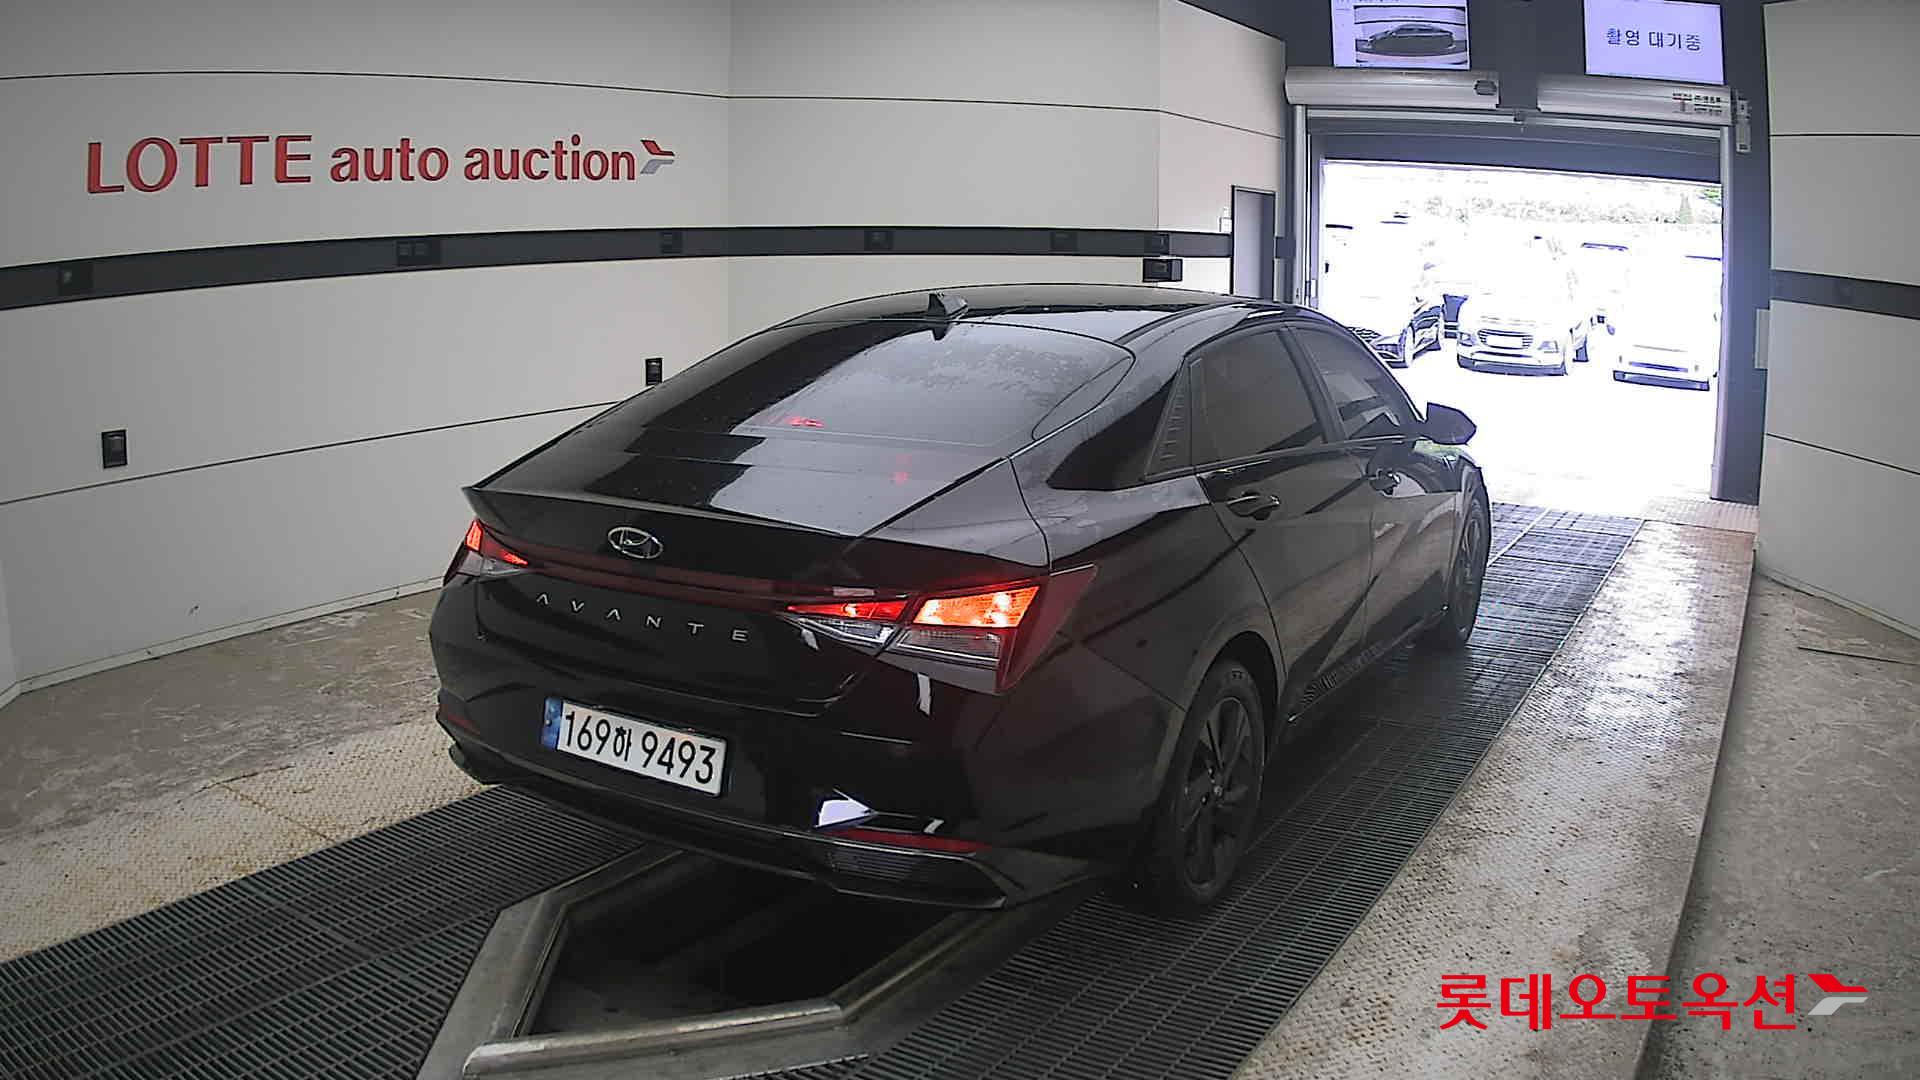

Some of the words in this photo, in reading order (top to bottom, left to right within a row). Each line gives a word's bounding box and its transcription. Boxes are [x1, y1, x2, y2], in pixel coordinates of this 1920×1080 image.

[1647, 31, 1701, 51] 대기중
[86, 134, 313, 194] LOTTE
[329, 137, 450, 183] auto
[463, 133, 636, 181] auction
[535, 592, 750, 642] AVANTE
[564, 710, 634, 763] 169하
[640, 731, 717, 785] 9493
